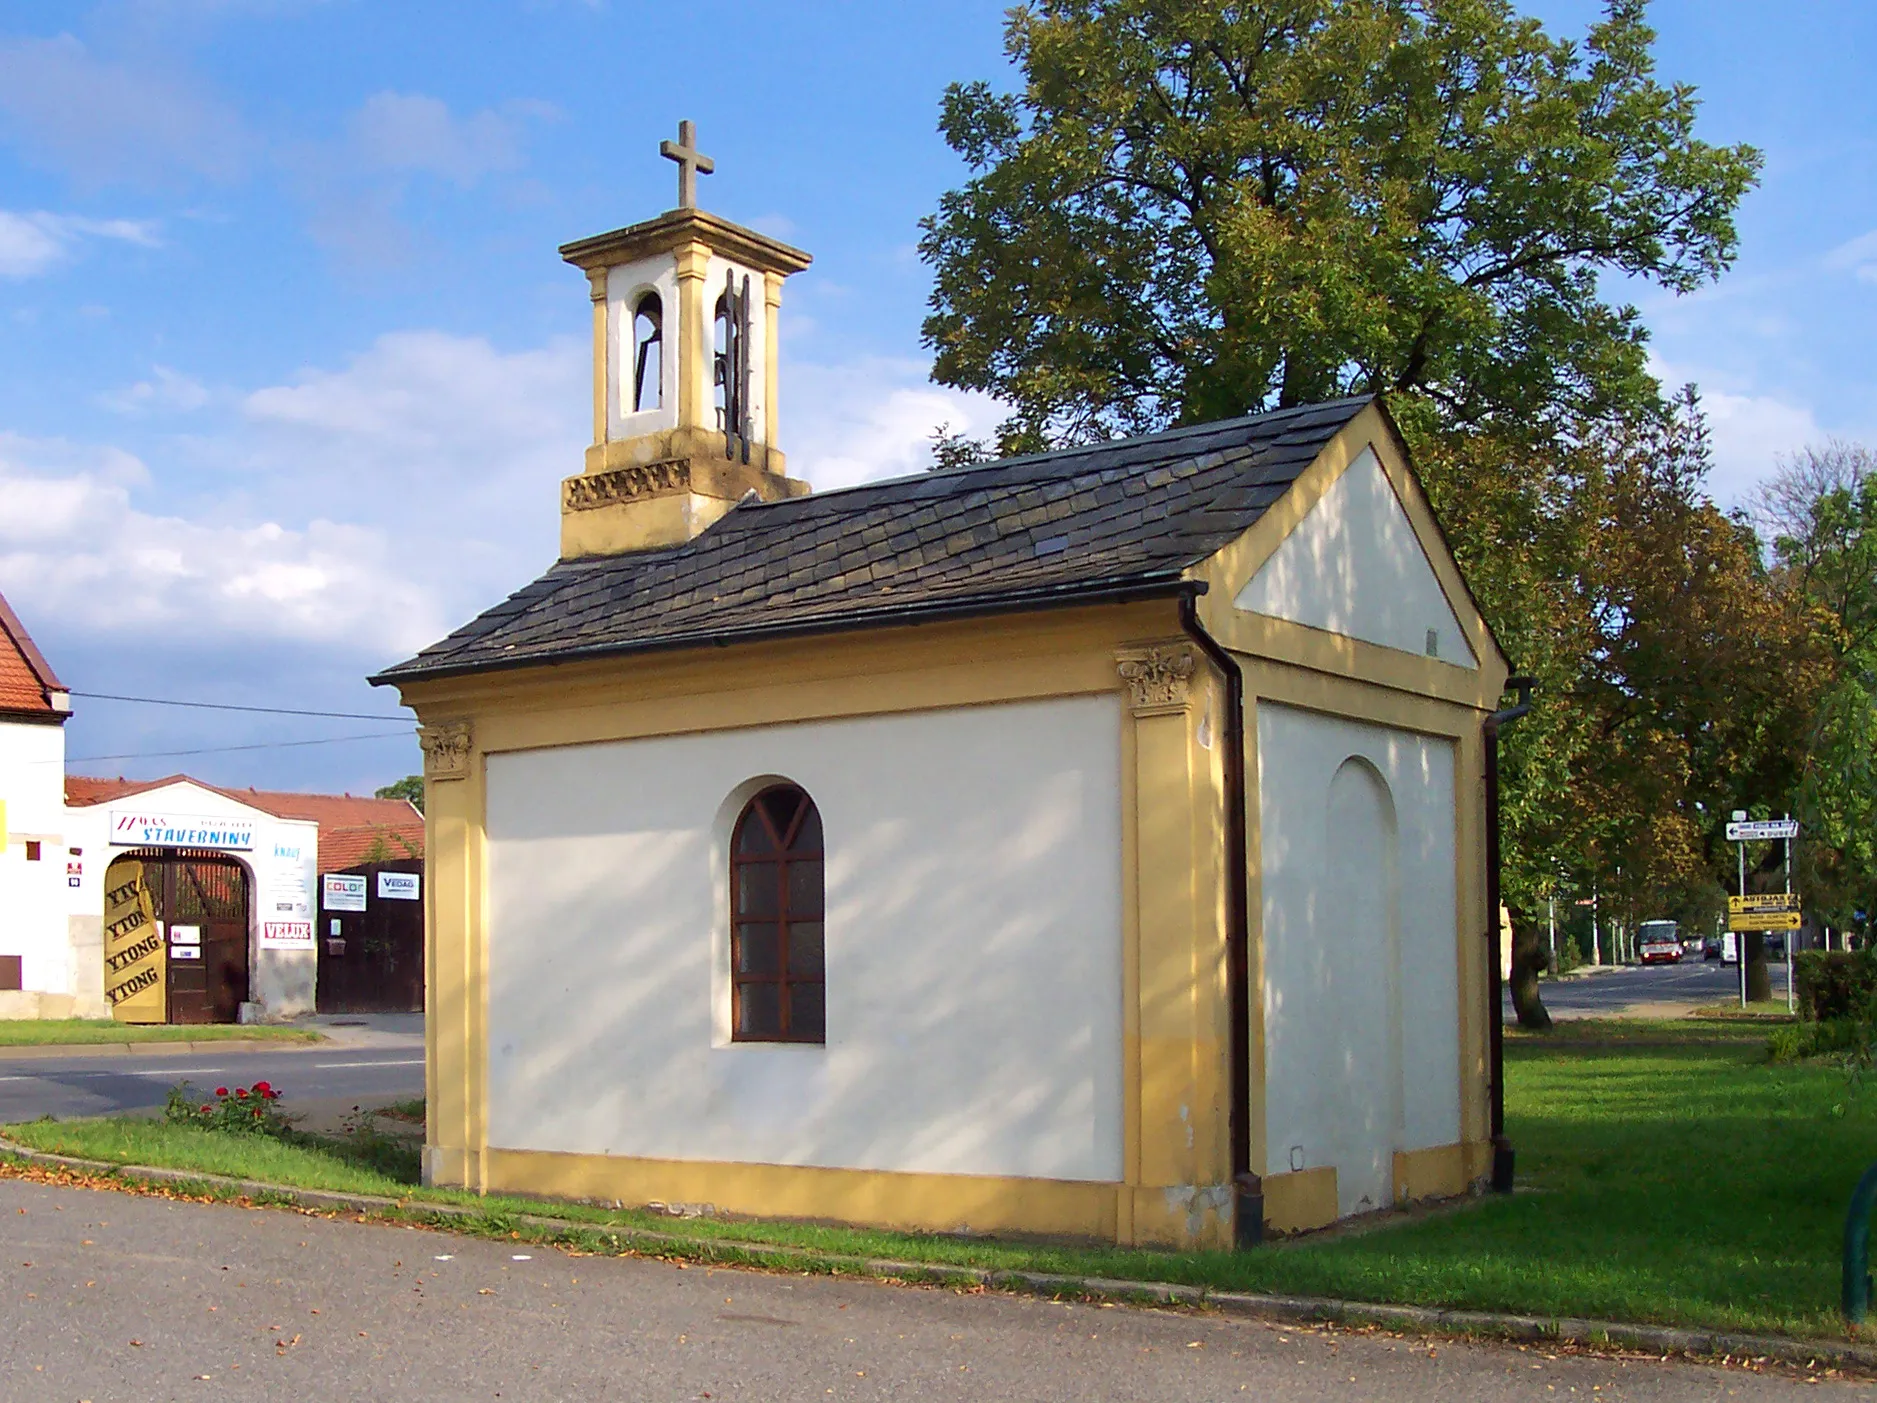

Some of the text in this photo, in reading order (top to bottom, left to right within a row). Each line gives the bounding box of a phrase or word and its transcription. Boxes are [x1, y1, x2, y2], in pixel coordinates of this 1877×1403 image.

[265, 923, 309, 939] VELUX
[106, 935, 160, 971] YTONG
[105, 967, 159, 1004] YTONG
